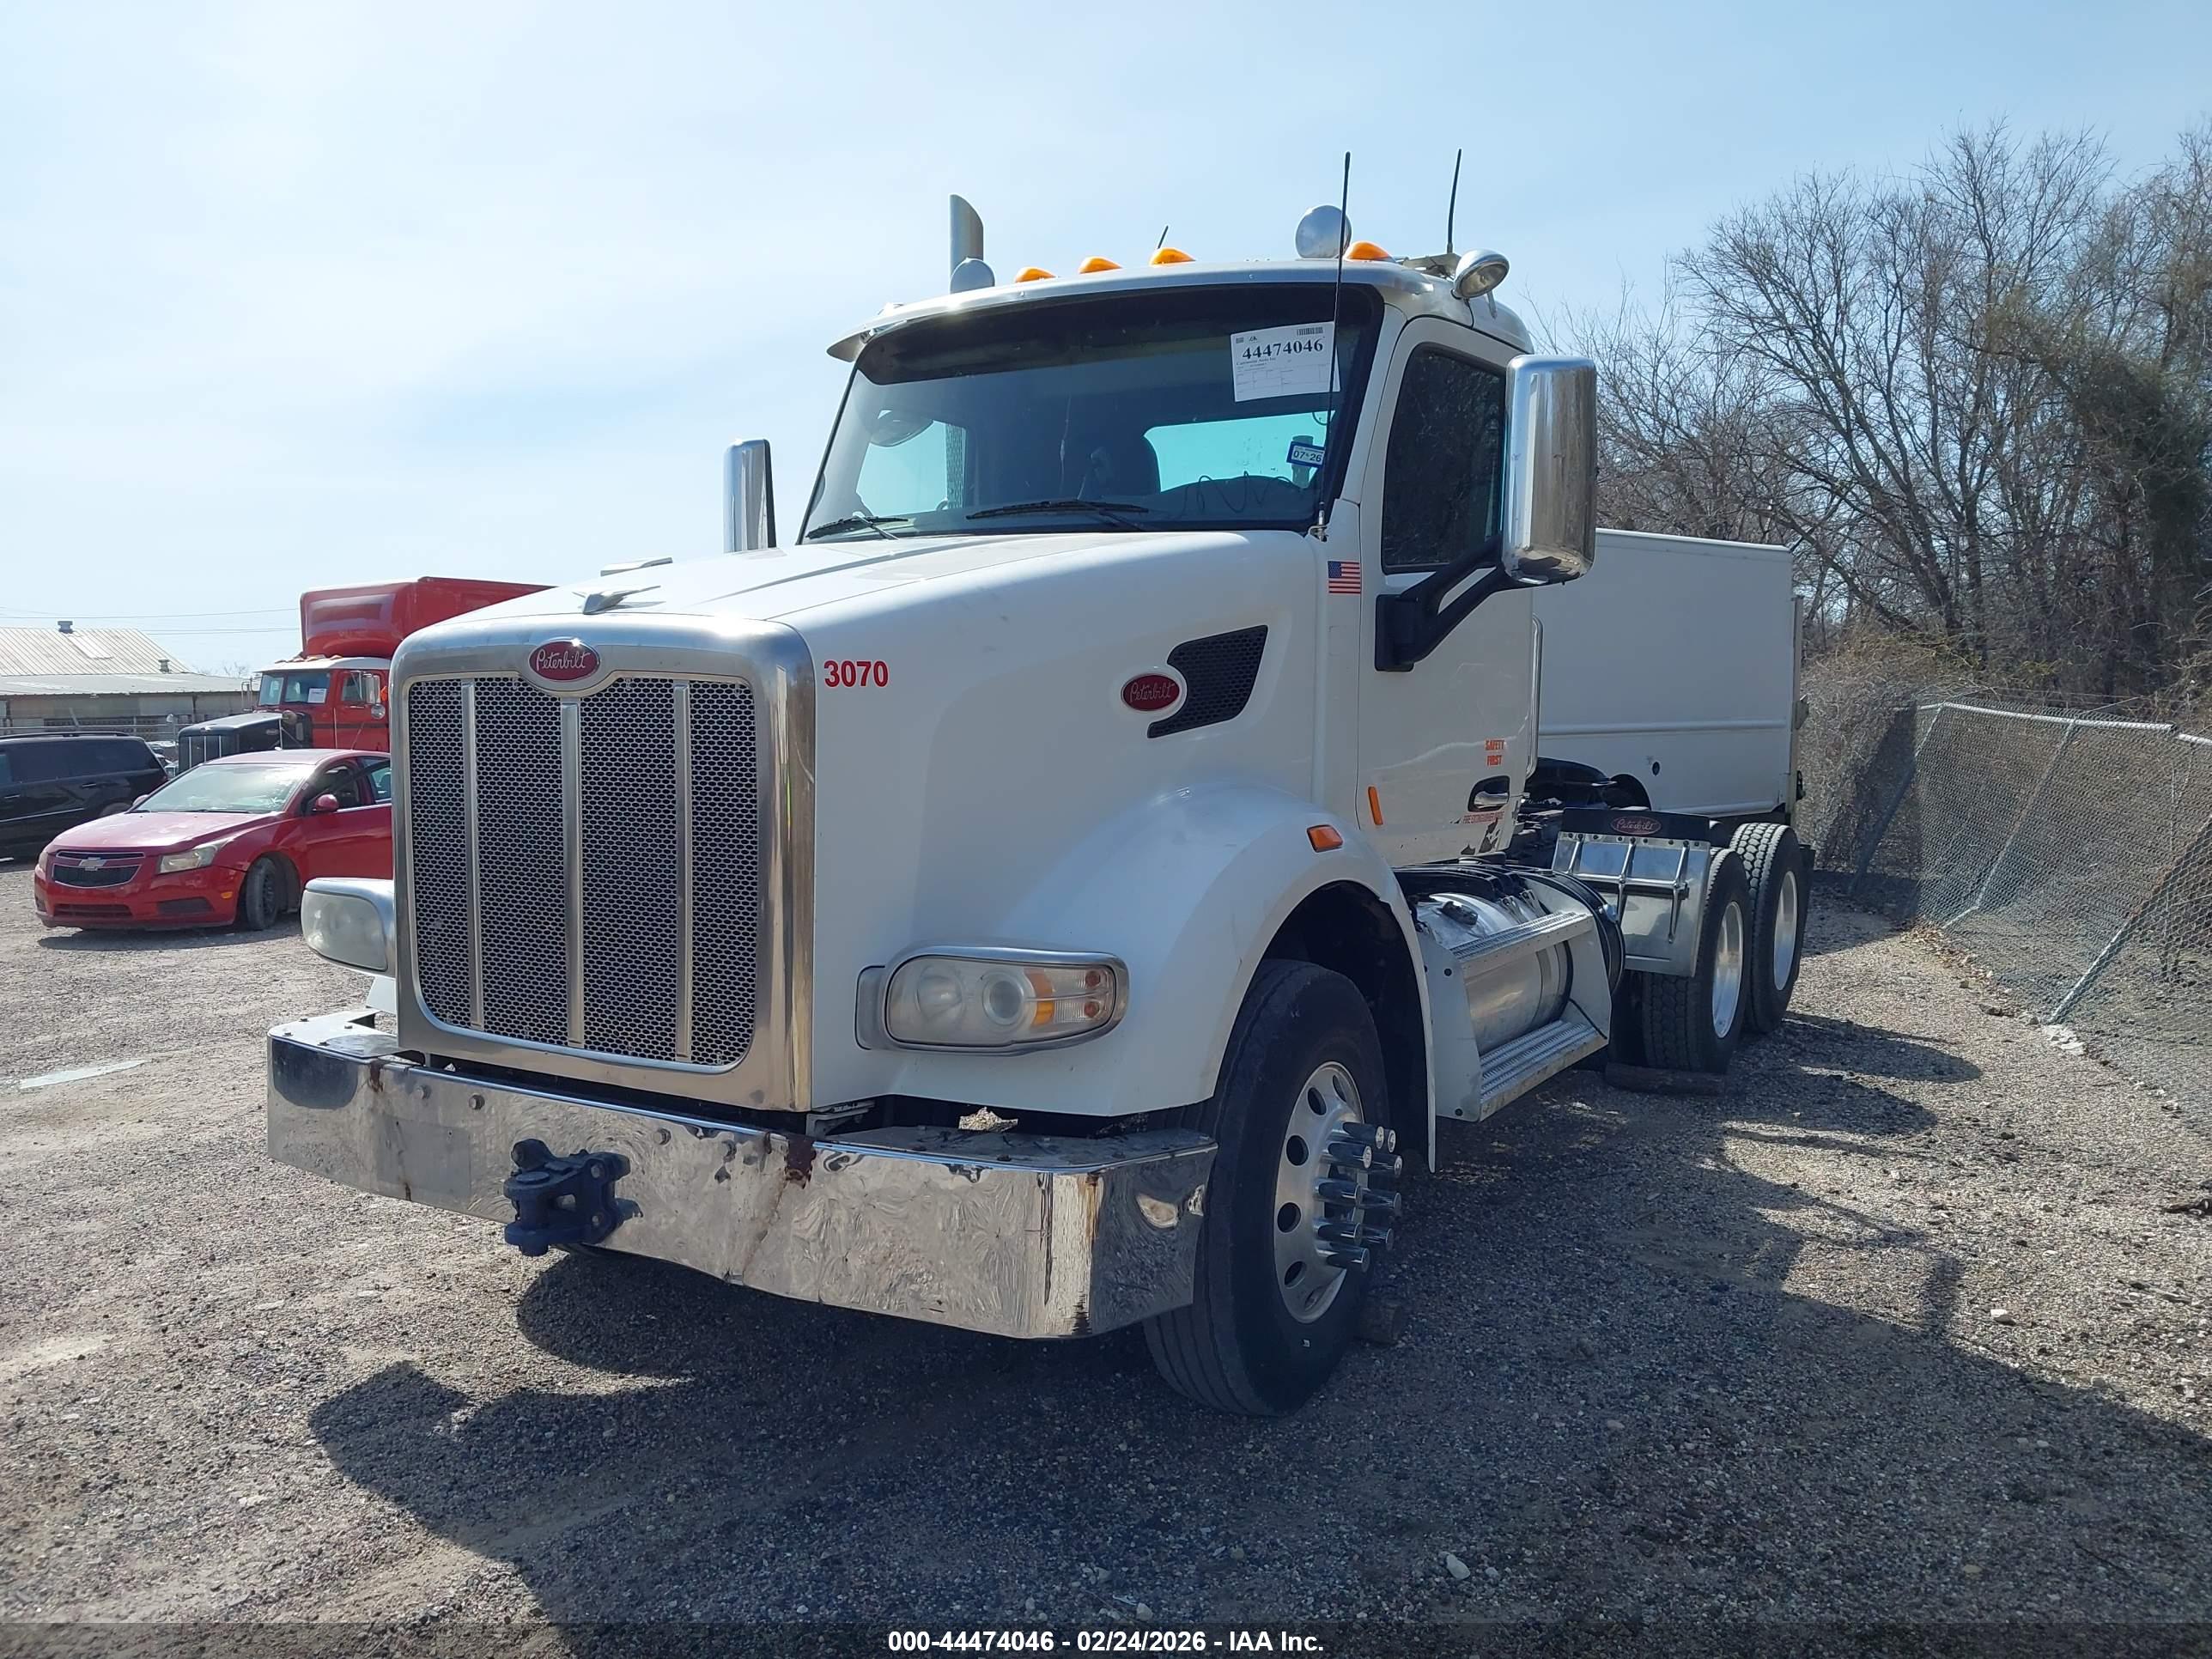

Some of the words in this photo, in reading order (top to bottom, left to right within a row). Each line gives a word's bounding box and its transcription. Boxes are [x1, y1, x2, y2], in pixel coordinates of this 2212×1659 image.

[1243, 338, 1323, 359] 44474046
[1310, 453, 1322, 462] 26
[536, 648, 592, 671] Peterbilt
[823, 659, 889, 688] 3070
[1130, 682, 1176, 702] Peterbilt
[1485, 739, 1504, 750] SAFETY
[1486, 755, 1502, 766] FIRST
[1616, 818, 1657, 830] Peterbilt
